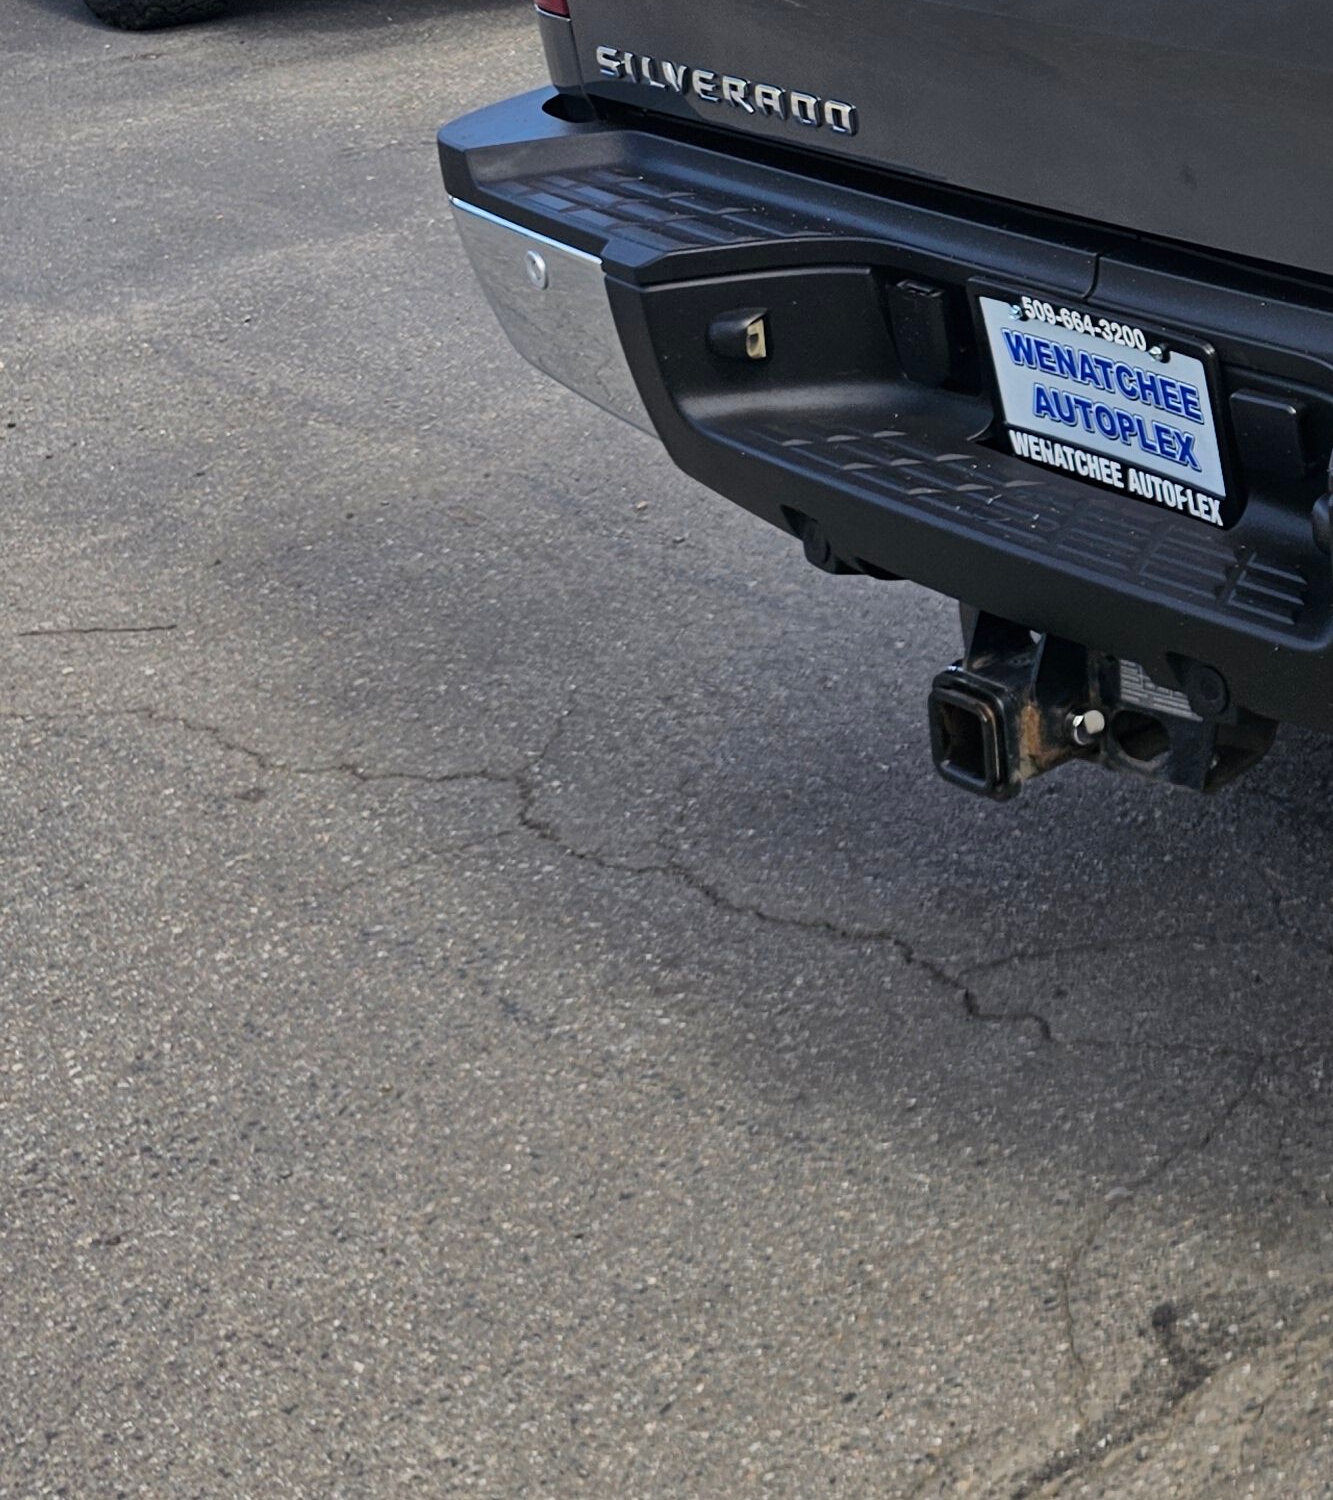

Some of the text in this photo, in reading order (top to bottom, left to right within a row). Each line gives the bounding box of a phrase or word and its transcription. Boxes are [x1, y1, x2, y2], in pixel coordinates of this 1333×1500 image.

[596, 45, 858, 137] SILVERADO
[1021, 295, 1147, 352] 509-664-3200
[1001, 328, 1205, 425] WENATCHEE
[1009, 429, 1125, 489] WENATCHEE
[1032, 382, 1203, 472] AUTOPLEX
